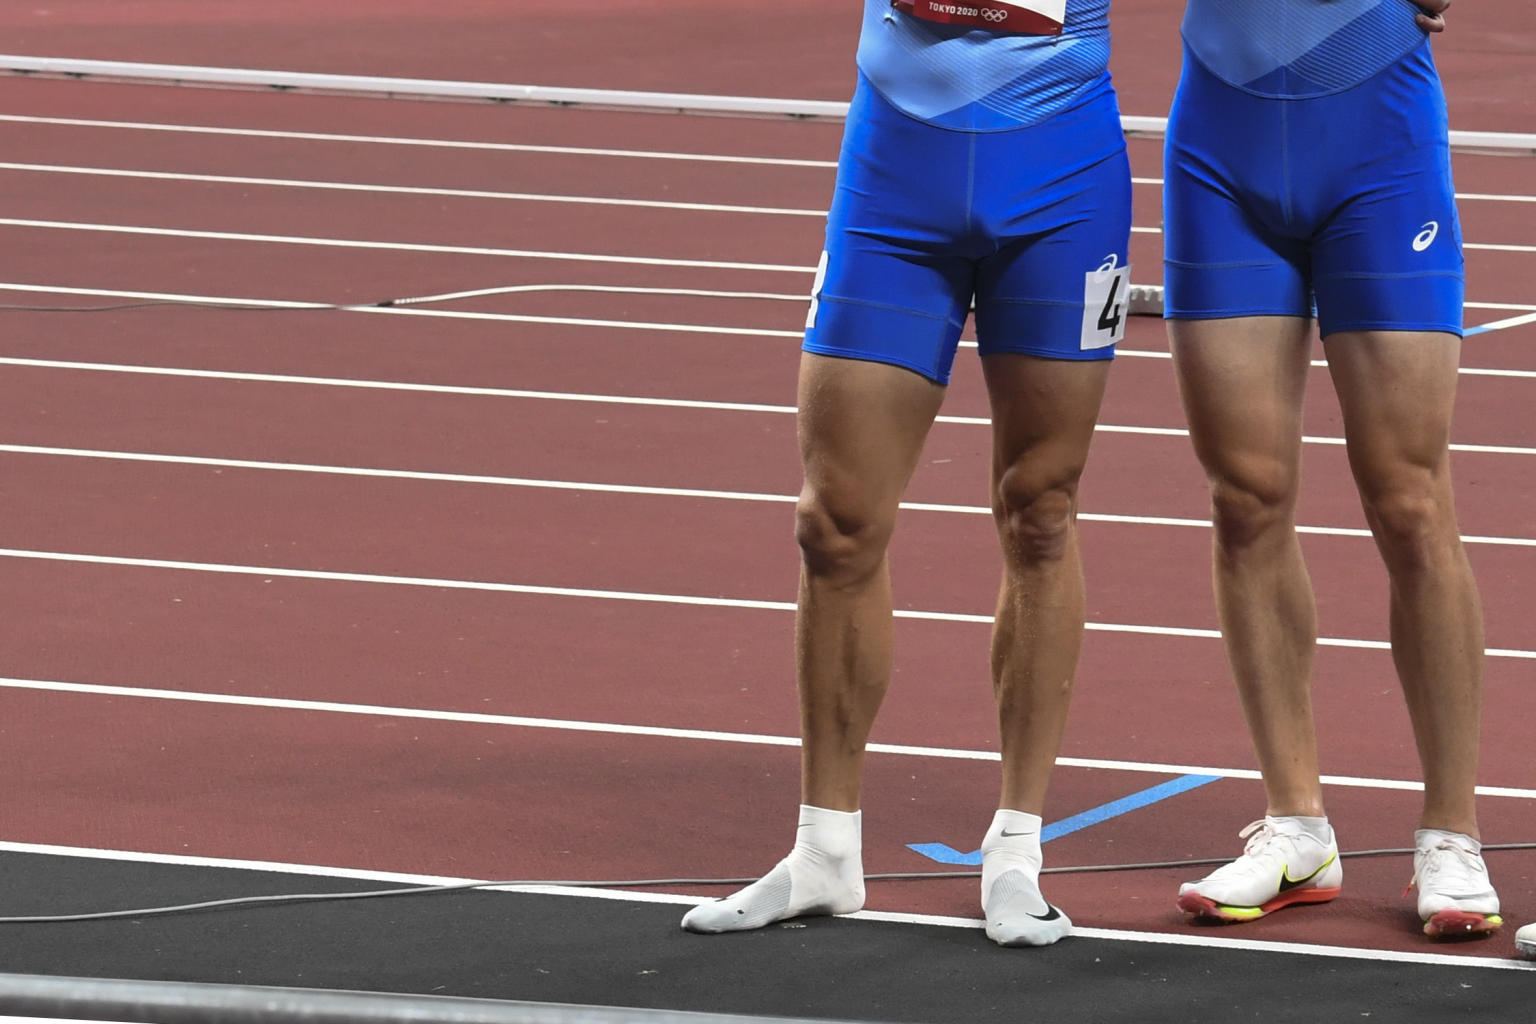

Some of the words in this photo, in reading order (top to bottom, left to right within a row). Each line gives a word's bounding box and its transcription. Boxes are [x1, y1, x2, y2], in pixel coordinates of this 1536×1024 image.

[928, 1, 956, 14] TOKYO
[956, 6, 979, 17] 2020
[1097, 275, 1121, 337] 4
